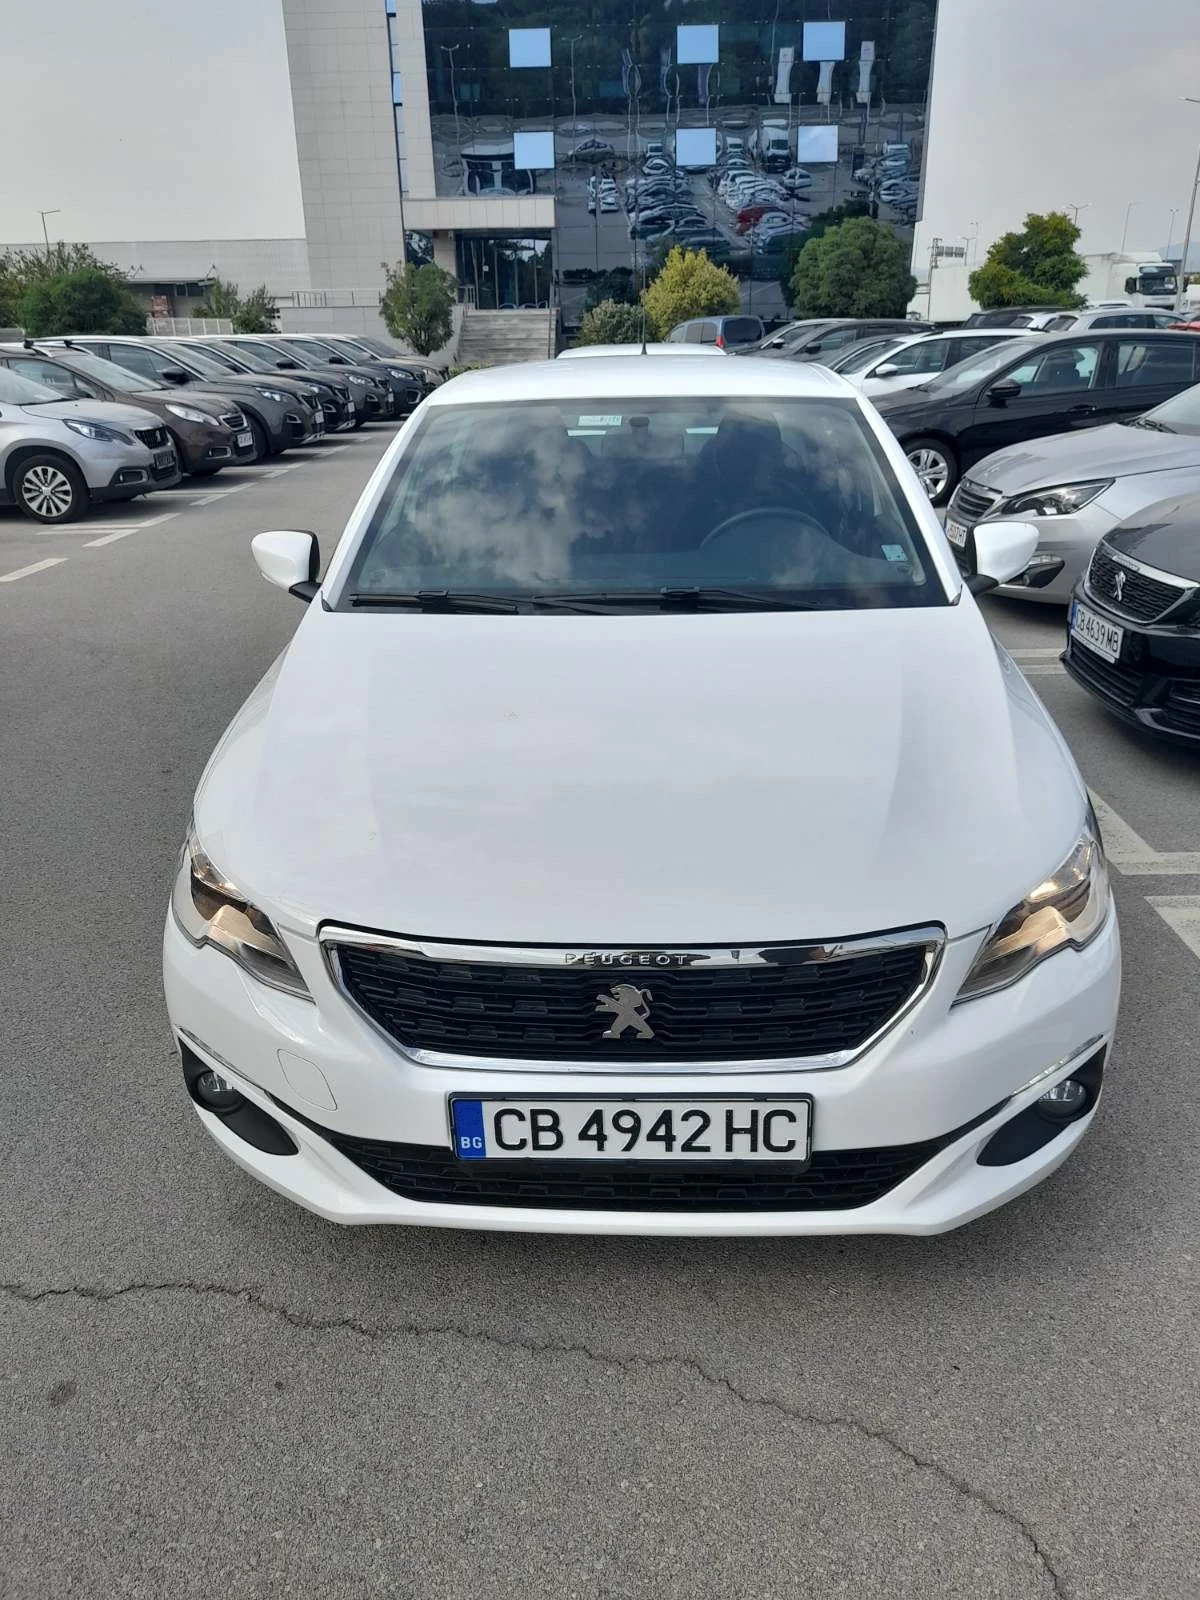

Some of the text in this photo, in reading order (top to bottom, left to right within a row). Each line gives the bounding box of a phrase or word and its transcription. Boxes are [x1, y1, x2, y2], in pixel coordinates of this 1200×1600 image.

[1086, 616, 1106, 646] 4639
[1106, 627, 1119, 653] MB
[564, 951, 689, 967] PEUGEOT
[460, 1136, 483, 1149] BG
[493, 1107, 797, 1153] CB 4942 HC
